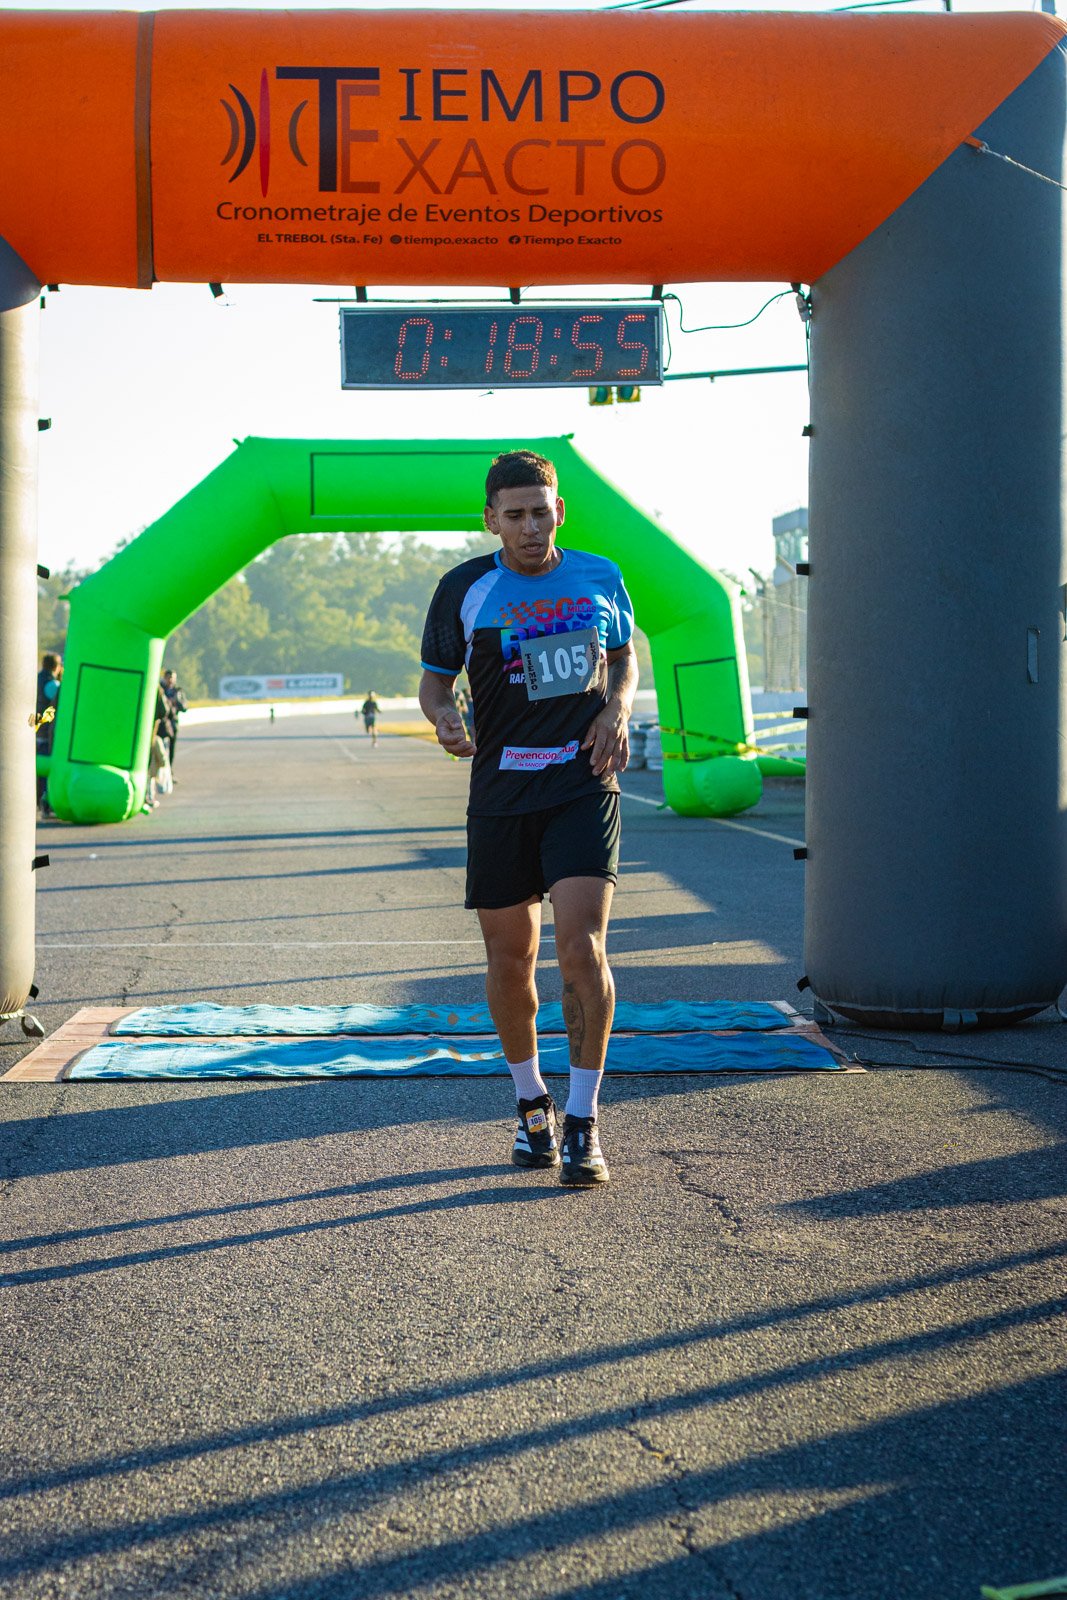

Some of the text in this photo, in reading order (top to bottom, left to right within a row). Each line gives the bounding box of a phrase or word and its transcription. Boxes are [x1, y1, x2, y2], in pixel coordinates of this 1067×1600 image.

[216, 201, 664, 227] Cronometraje de Eventos Deportivos
[257, 233, 622, 247] EL TREBOL (Sta. Fe) tiempo.exacto Tiempo Exacto
[534, 597, 594, 624] 500
[567, 605, 597, 613] MILLAS
[538, 644, 589, 684] 105
[509, 673, 527, 684] RAF
[525, 653, 538, 691] TIEMPO
[505, 749, 558, 760] Prevención
[530, 1115, 543, 1125] 105
